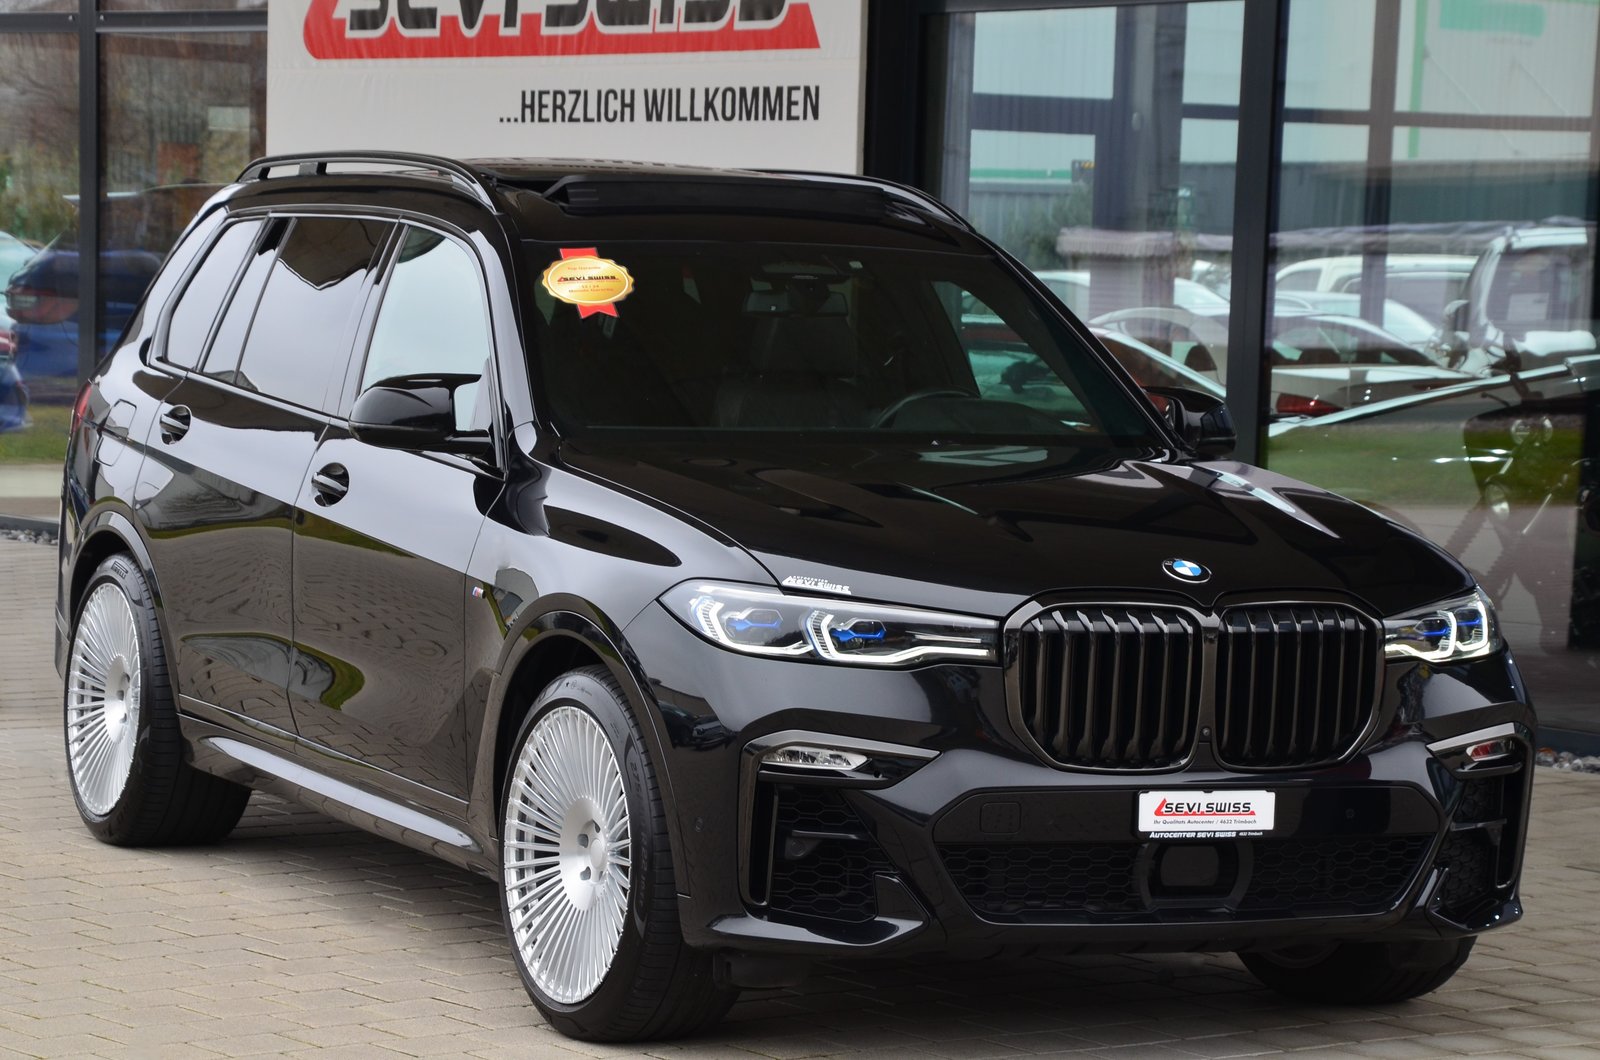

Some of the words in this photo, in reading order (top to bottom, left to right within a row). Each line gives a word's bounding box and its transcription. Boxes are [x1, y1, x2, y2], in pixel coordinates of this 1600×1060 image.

[499, 88, 636, 123] ...HERZLICH
[643, 85, 820, 122] WILLKOMMEN
[816, 582, 850, 593] SWISS
[1164, 802, 1201, 813] SEVI
[1205, 802, 1251, 813] SWISS
